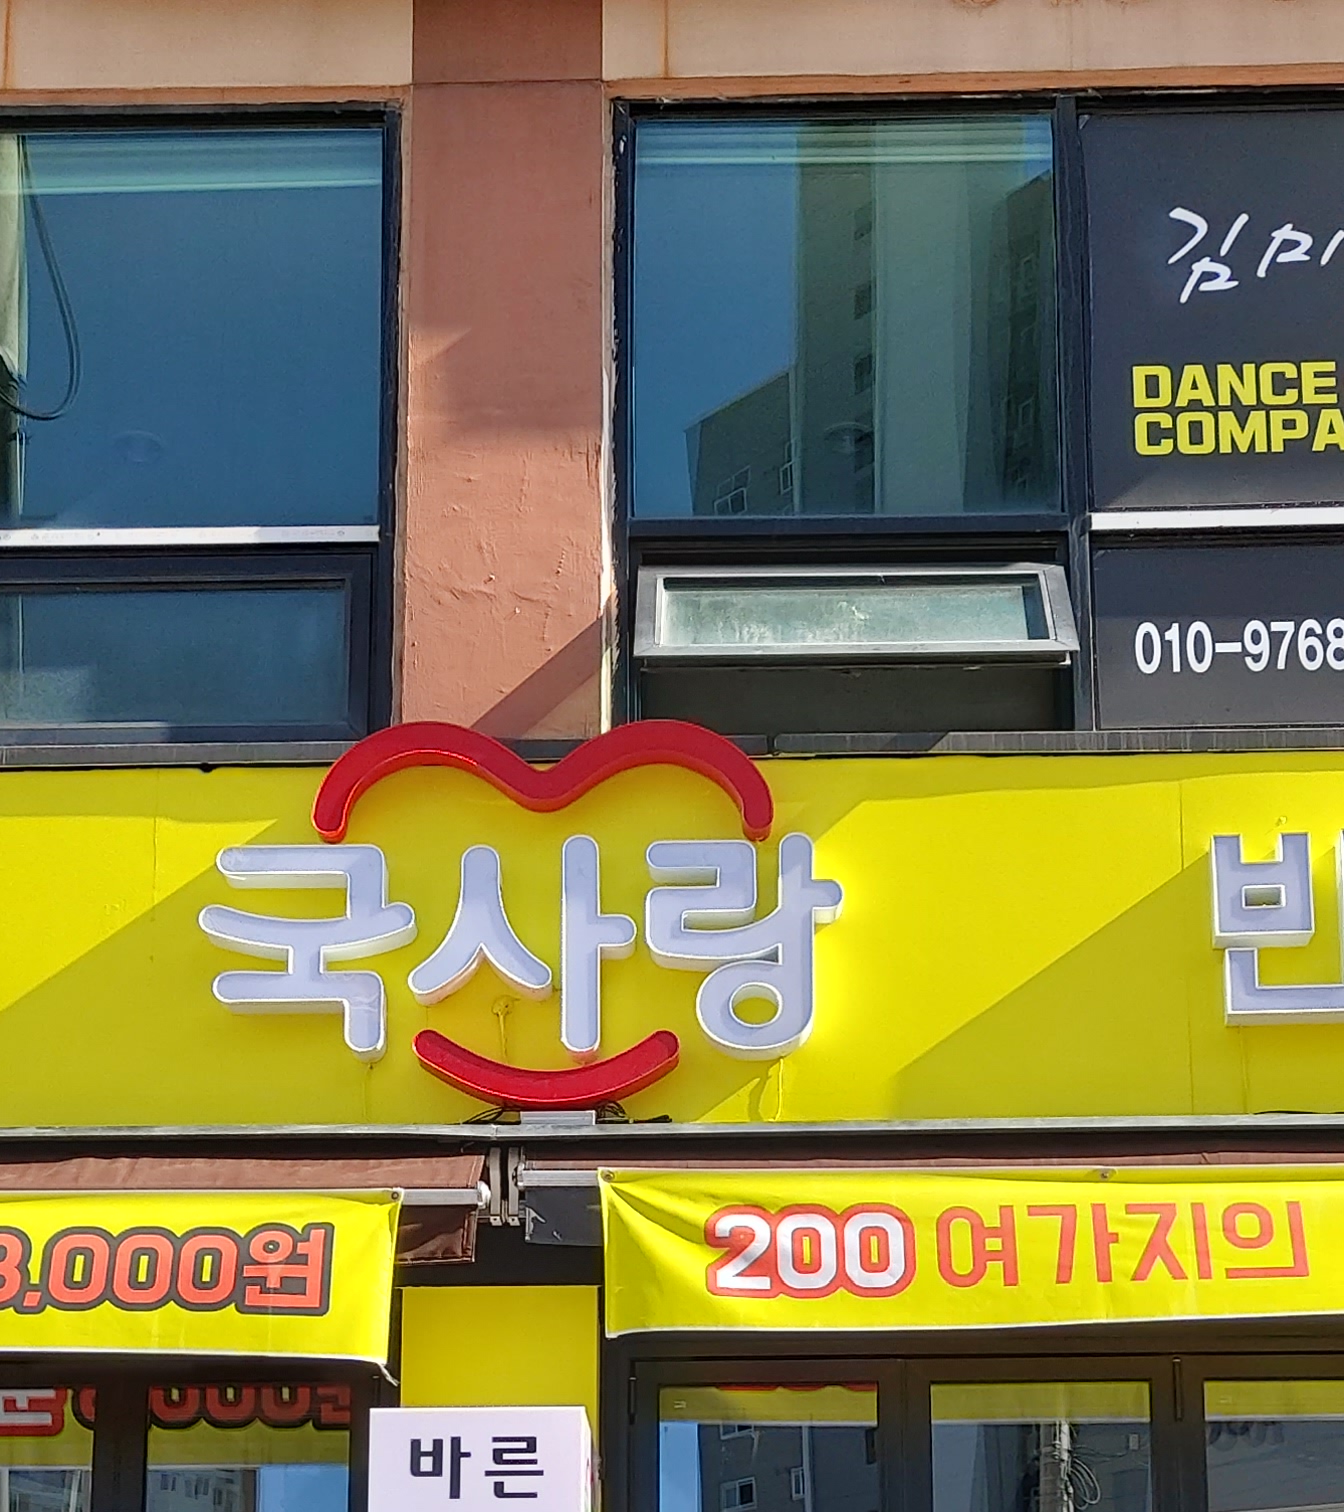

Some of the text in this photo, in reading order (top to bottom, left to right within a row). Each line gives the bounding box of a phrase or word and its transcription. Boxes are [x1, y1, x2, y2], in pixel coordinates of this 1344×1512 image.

[1131, 361, 1338, 407] DANCE
[198, 832, 844, 1062] 국사랑
[936, 1200, 1310, 1287] 여가지의
[410, 1435, 545, 1500] 바른
